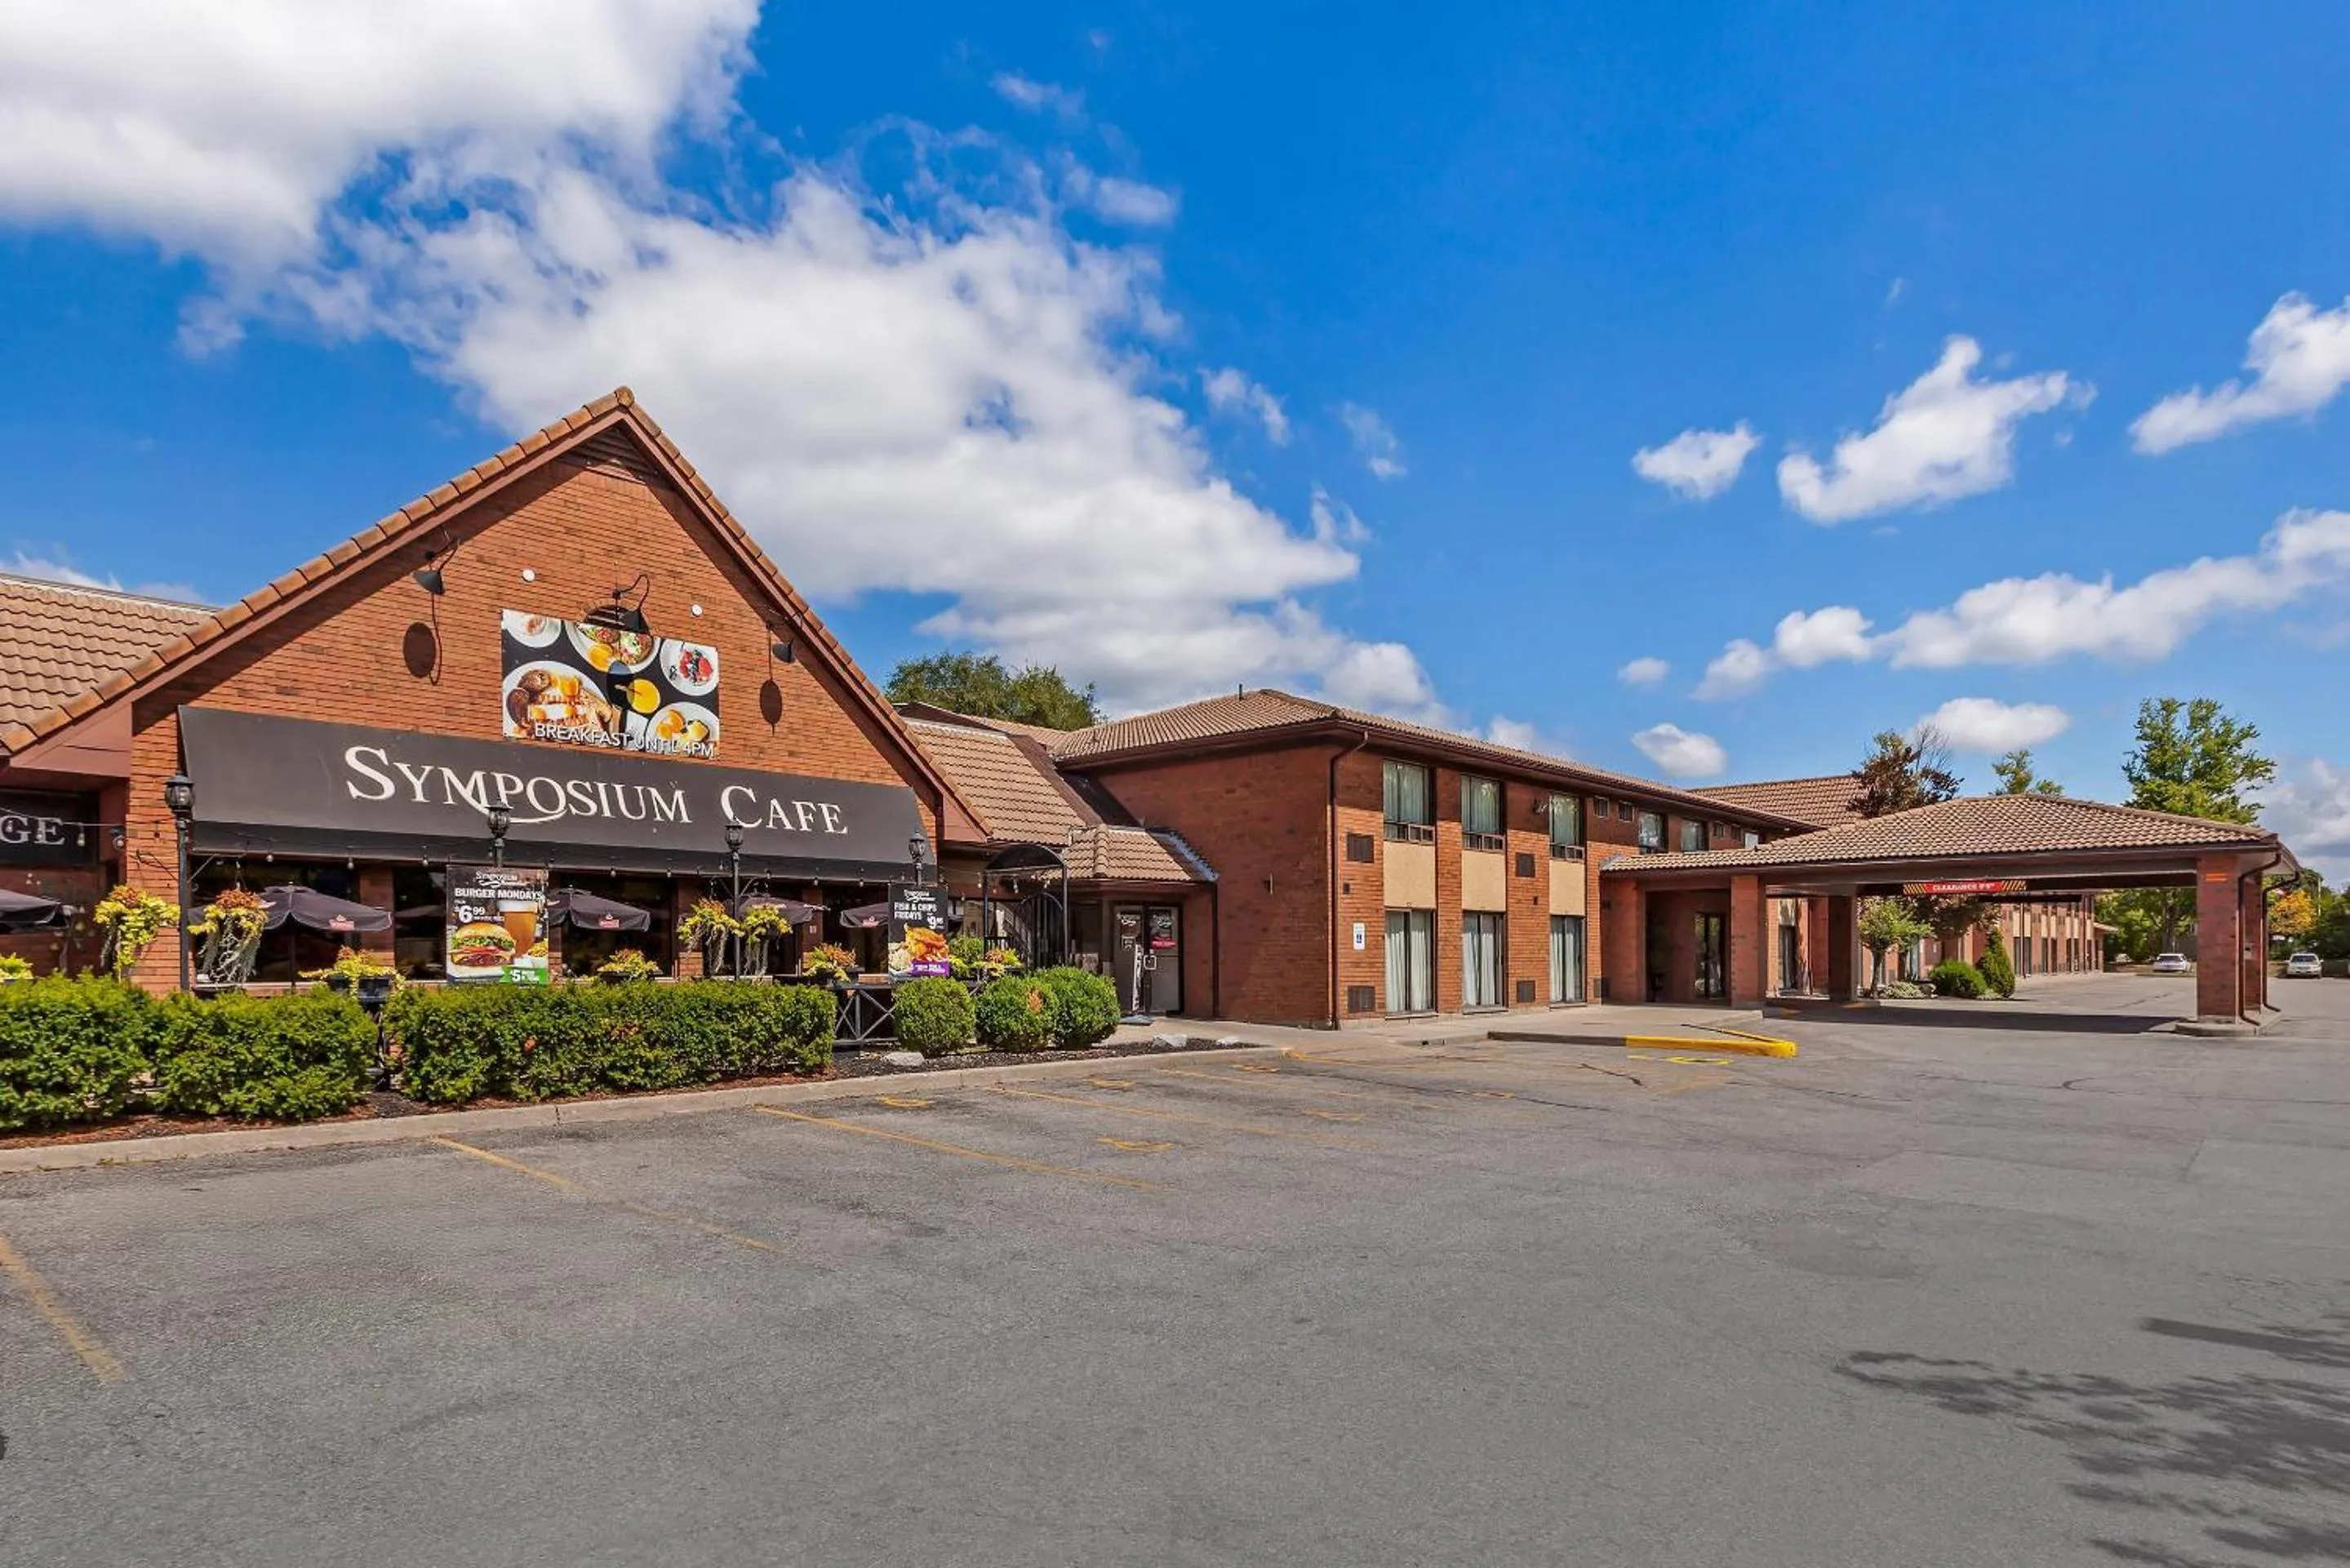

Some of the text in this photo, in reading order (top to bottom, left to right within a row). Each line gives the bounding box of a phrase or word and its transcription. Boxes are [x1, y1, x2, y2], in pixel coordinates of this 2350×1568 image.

[535, 723, 715, 757] BREAKFAST UNTIL 4PM
[344, 745, 850, 835] SYMPOSIUM CAFE
[454, 887, 544, 902] BURGER MONDAYS
[1932, 883, 1978, 891] CLEARANCE
